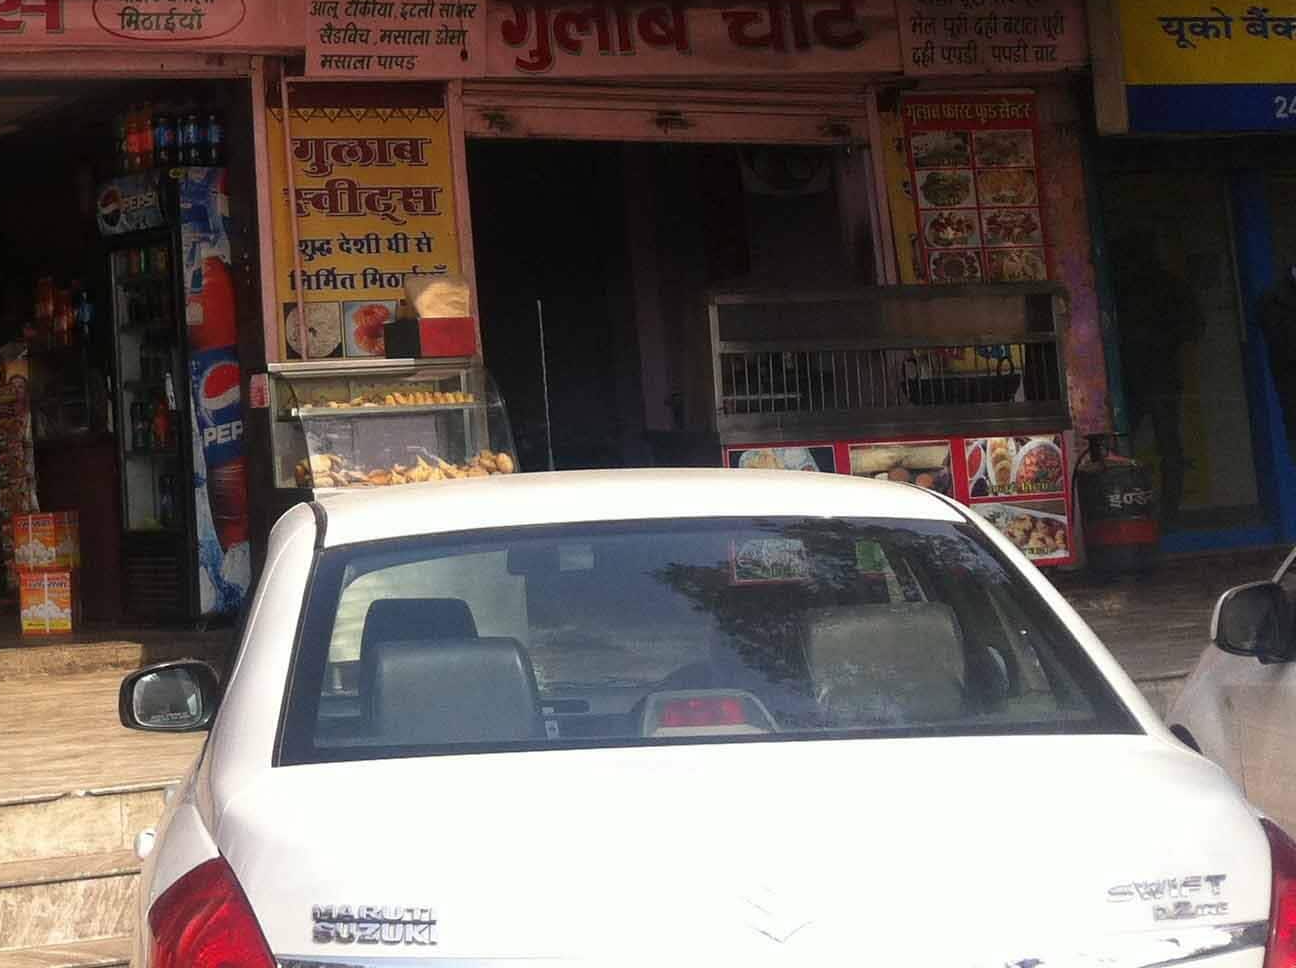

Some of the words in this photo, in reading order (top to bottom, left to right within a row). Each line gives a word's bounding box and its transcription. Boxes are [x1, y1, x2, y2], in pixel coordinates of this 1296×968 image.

[380, 29, 432, 46] मसाला
[1156, 6, 1235, 50] यूको
[320, 54, 372, 70] मसाला
[292, 137, 432, 177] गुलाब
[338, 233, 381, 255] देशी
[386, 233, 410, 254] घी
[415, 232, 433, 253] से
[312, 904, 437, 921] MARUTI
[312, 922, 438, 945] SUZUKI
